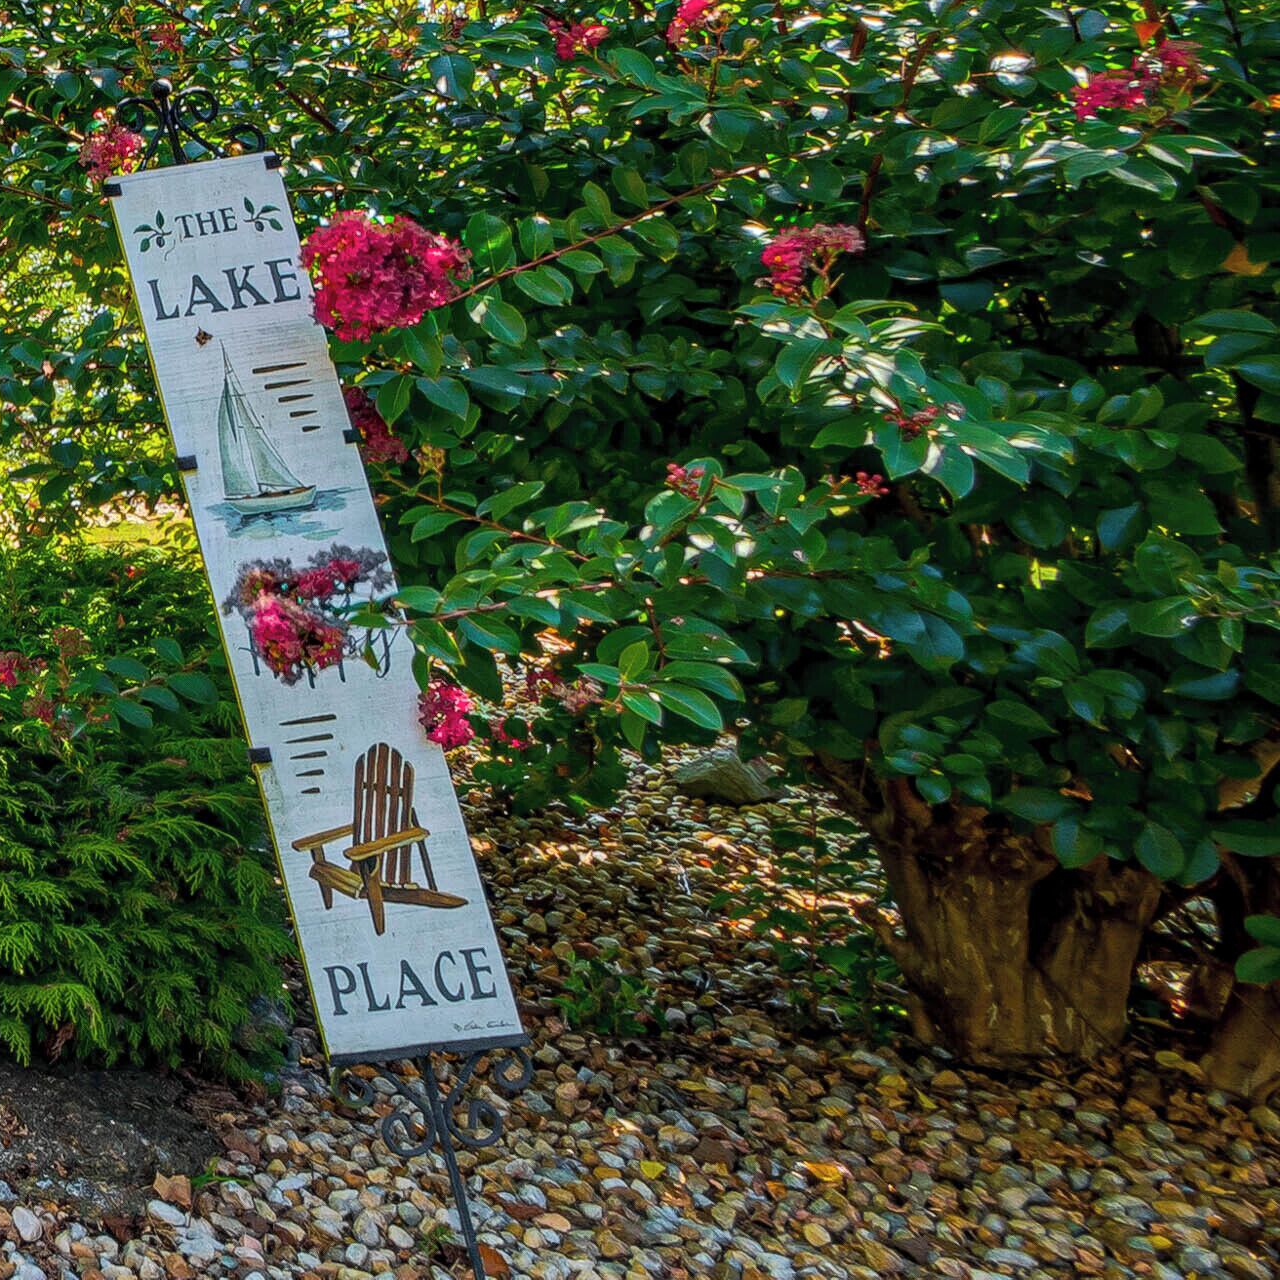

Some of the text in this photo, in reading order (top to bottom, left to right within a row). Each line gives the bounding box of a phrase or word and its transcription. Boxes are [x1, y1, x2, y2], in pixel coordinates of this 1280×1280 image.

[174, 207, 238, 240] THE
[146, 257, 302, 321] LAKE
[322, 947, 497, 1016] PLACE
